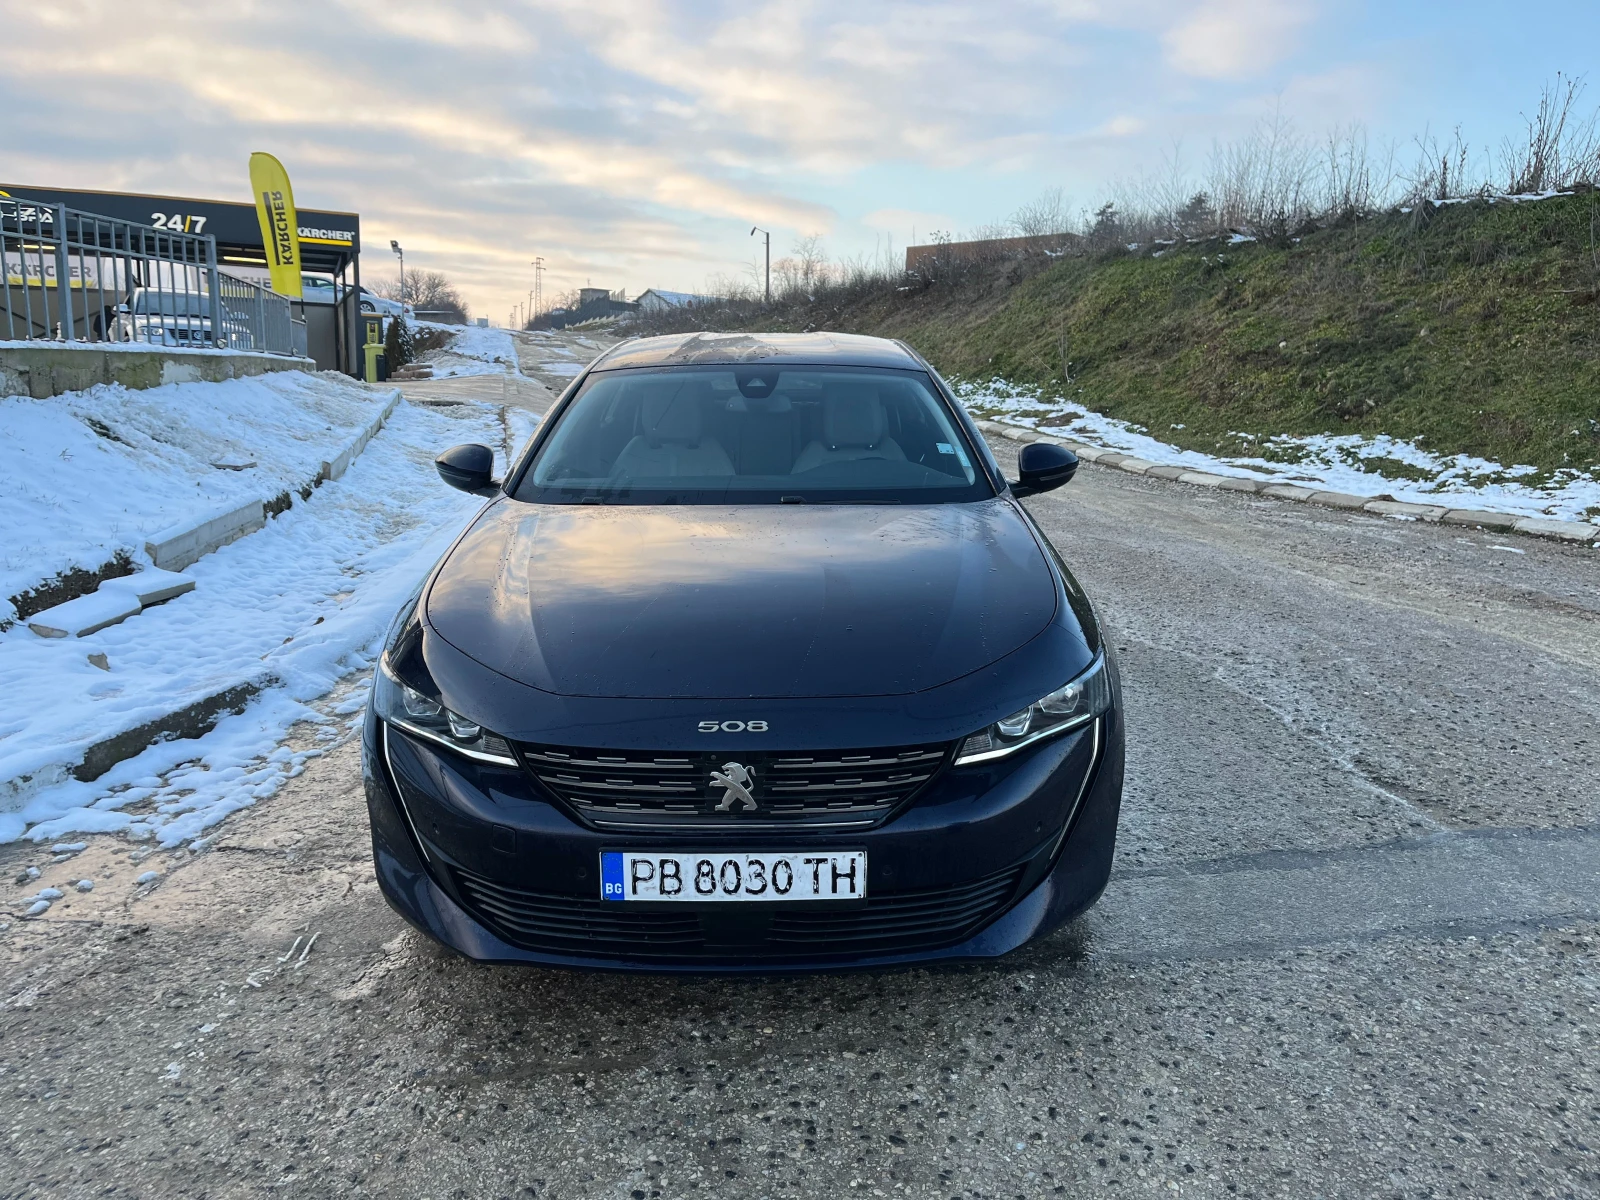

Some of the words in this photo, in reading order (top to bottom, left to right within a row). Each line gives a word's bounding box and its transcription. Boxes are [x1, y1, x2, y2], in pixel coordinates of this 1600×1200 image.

[151, 212, 207, 233] 24/7
[6, 262, 92, 278] KÄRCER
[697, 720, 769, 733] 508
[631, 858, 683, 896] PB
[694, 858, 793, 896] 8030
[804, 857, 856, 895] TH
[605, 883, 623, 894] BG
